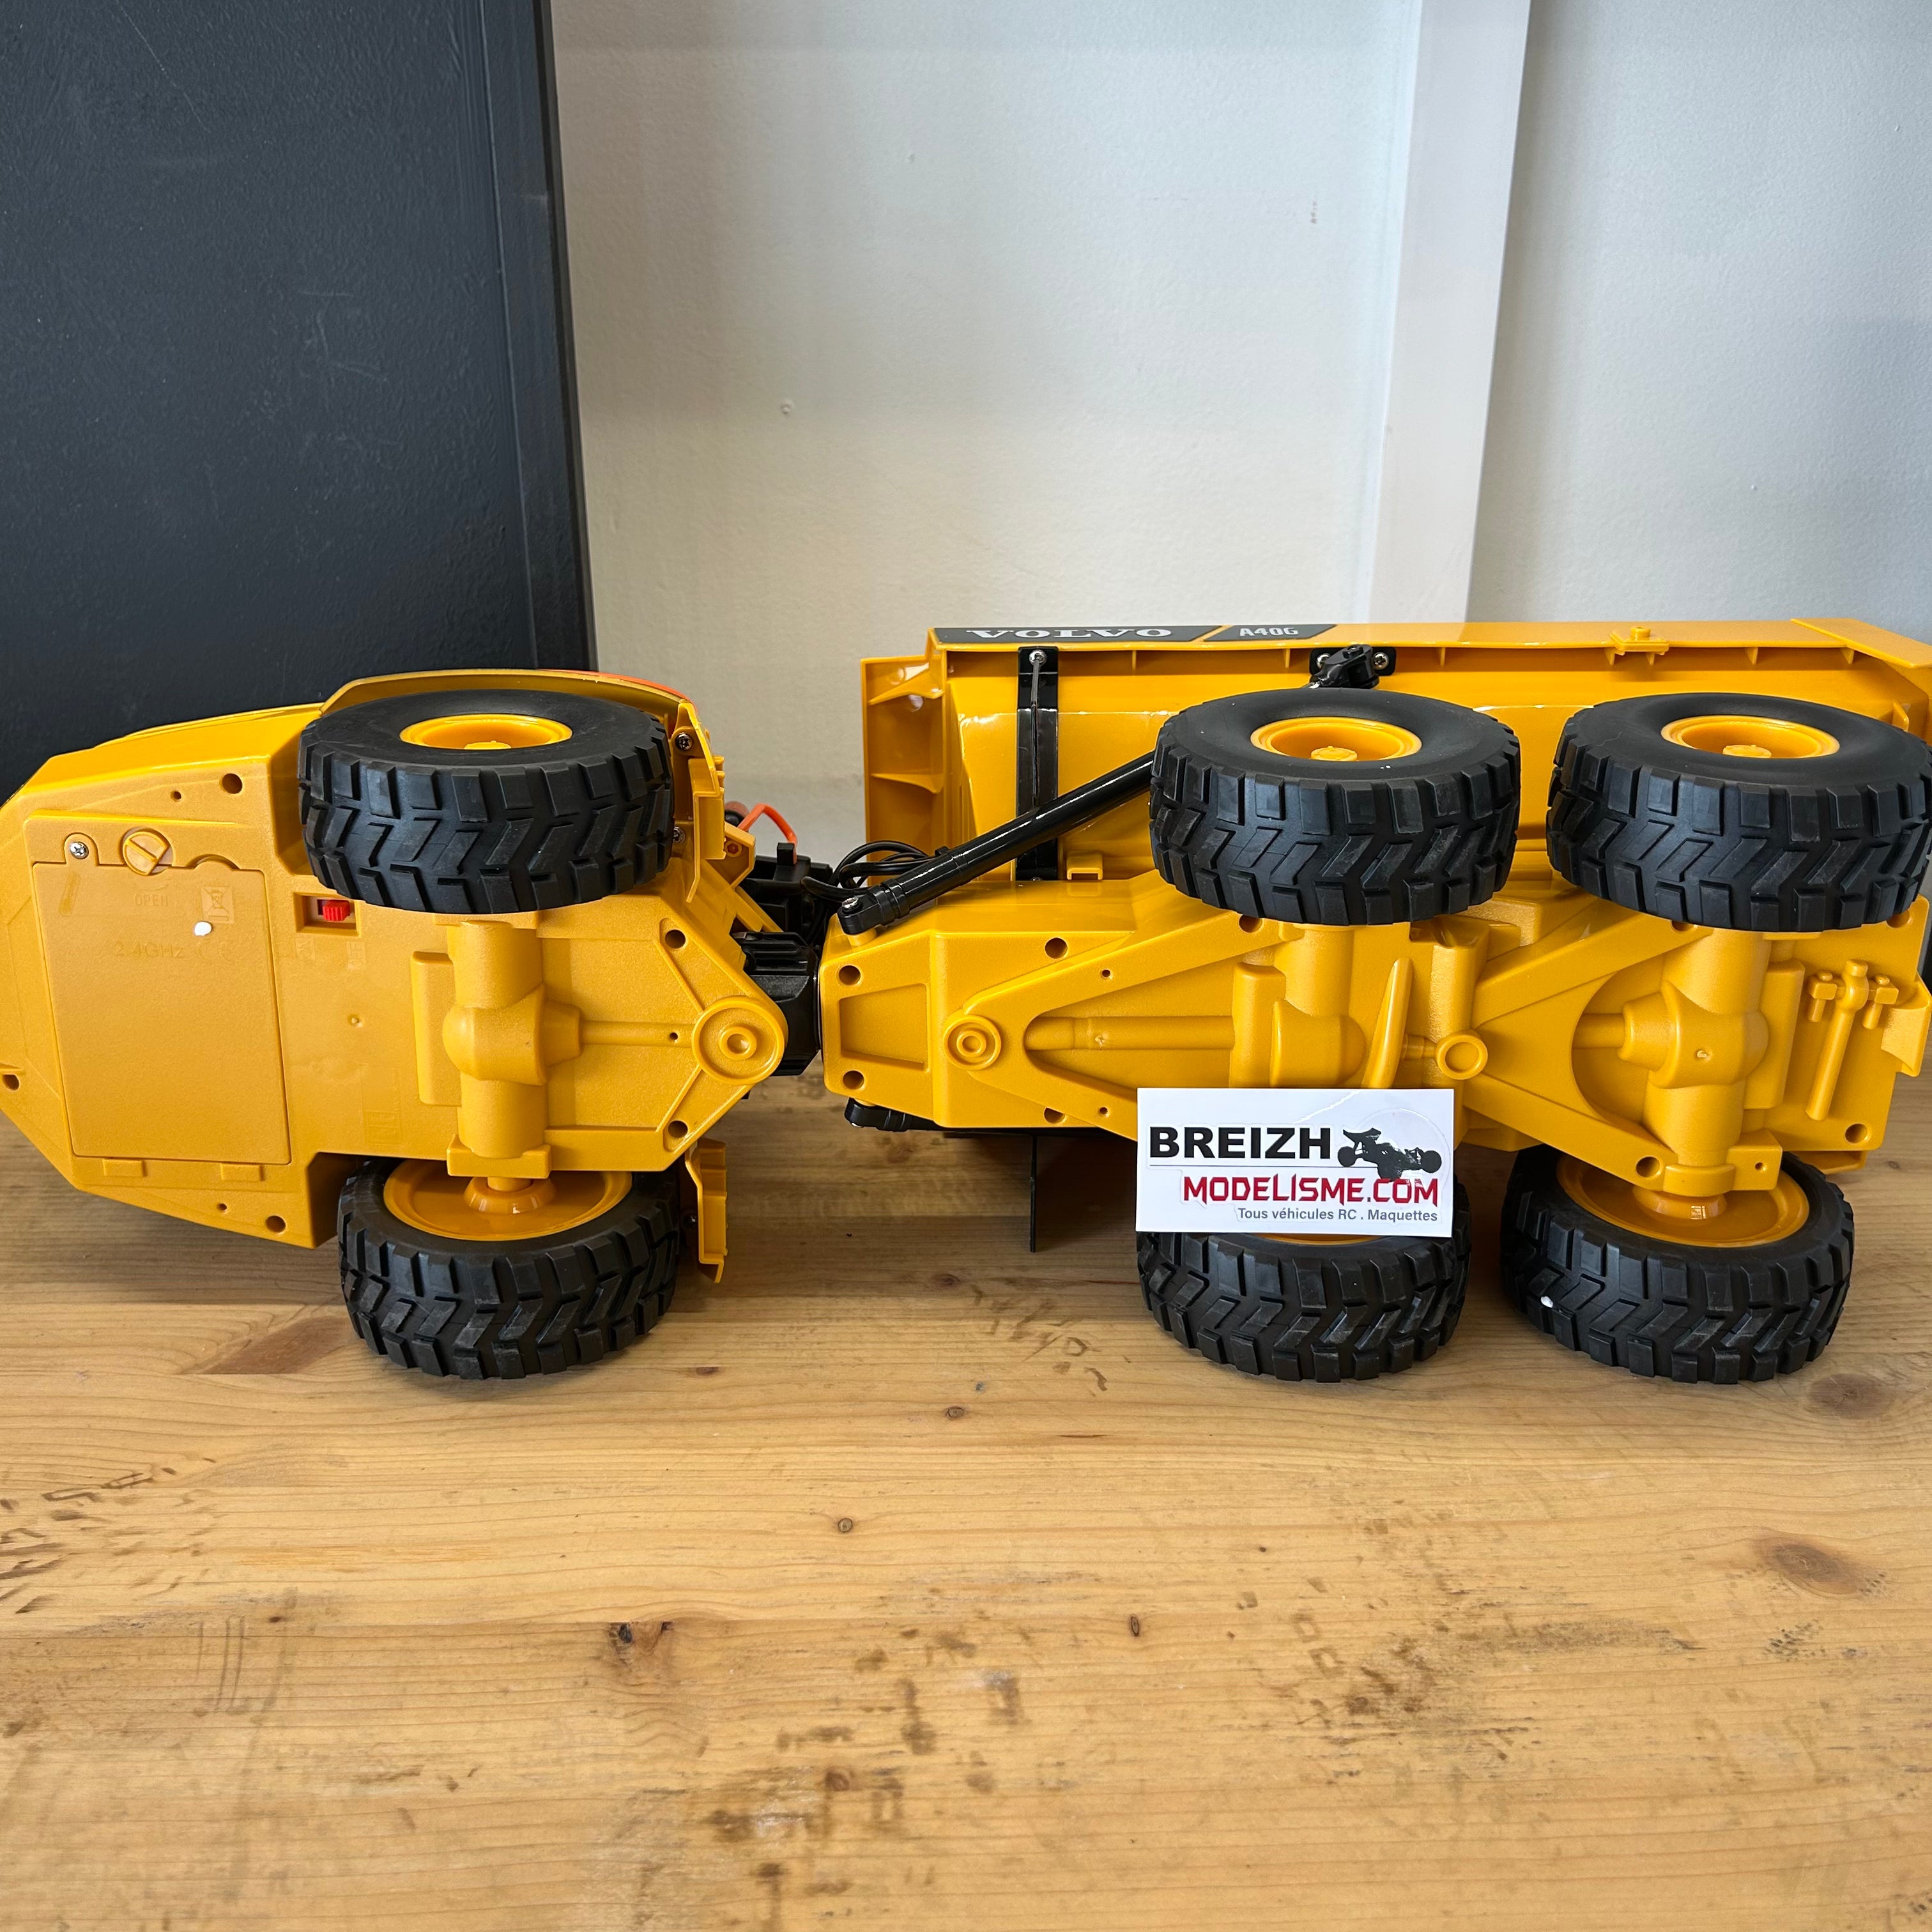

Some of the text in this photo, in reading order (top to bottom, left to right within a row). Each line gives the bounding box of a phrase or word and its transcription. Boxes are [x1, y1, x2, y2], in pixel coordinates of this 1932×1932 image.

[966, 628, 1172, 639] VOLVO
[1239, 627, 1299, 637] A40G
[134, 893, 170, 907] OPEN
[1149, 1126, 1331, 1160] BREIZH
[1183, 1173, 1439, 1208] MODELISME.COM
[1238, 1208, 1268, 1220] Tous
[1272, 1208, 1334, 1220] véhicules
[1338, 1209, 1358, 1220] RC
[1368, 1209, 1438, 1223] Maquettes
